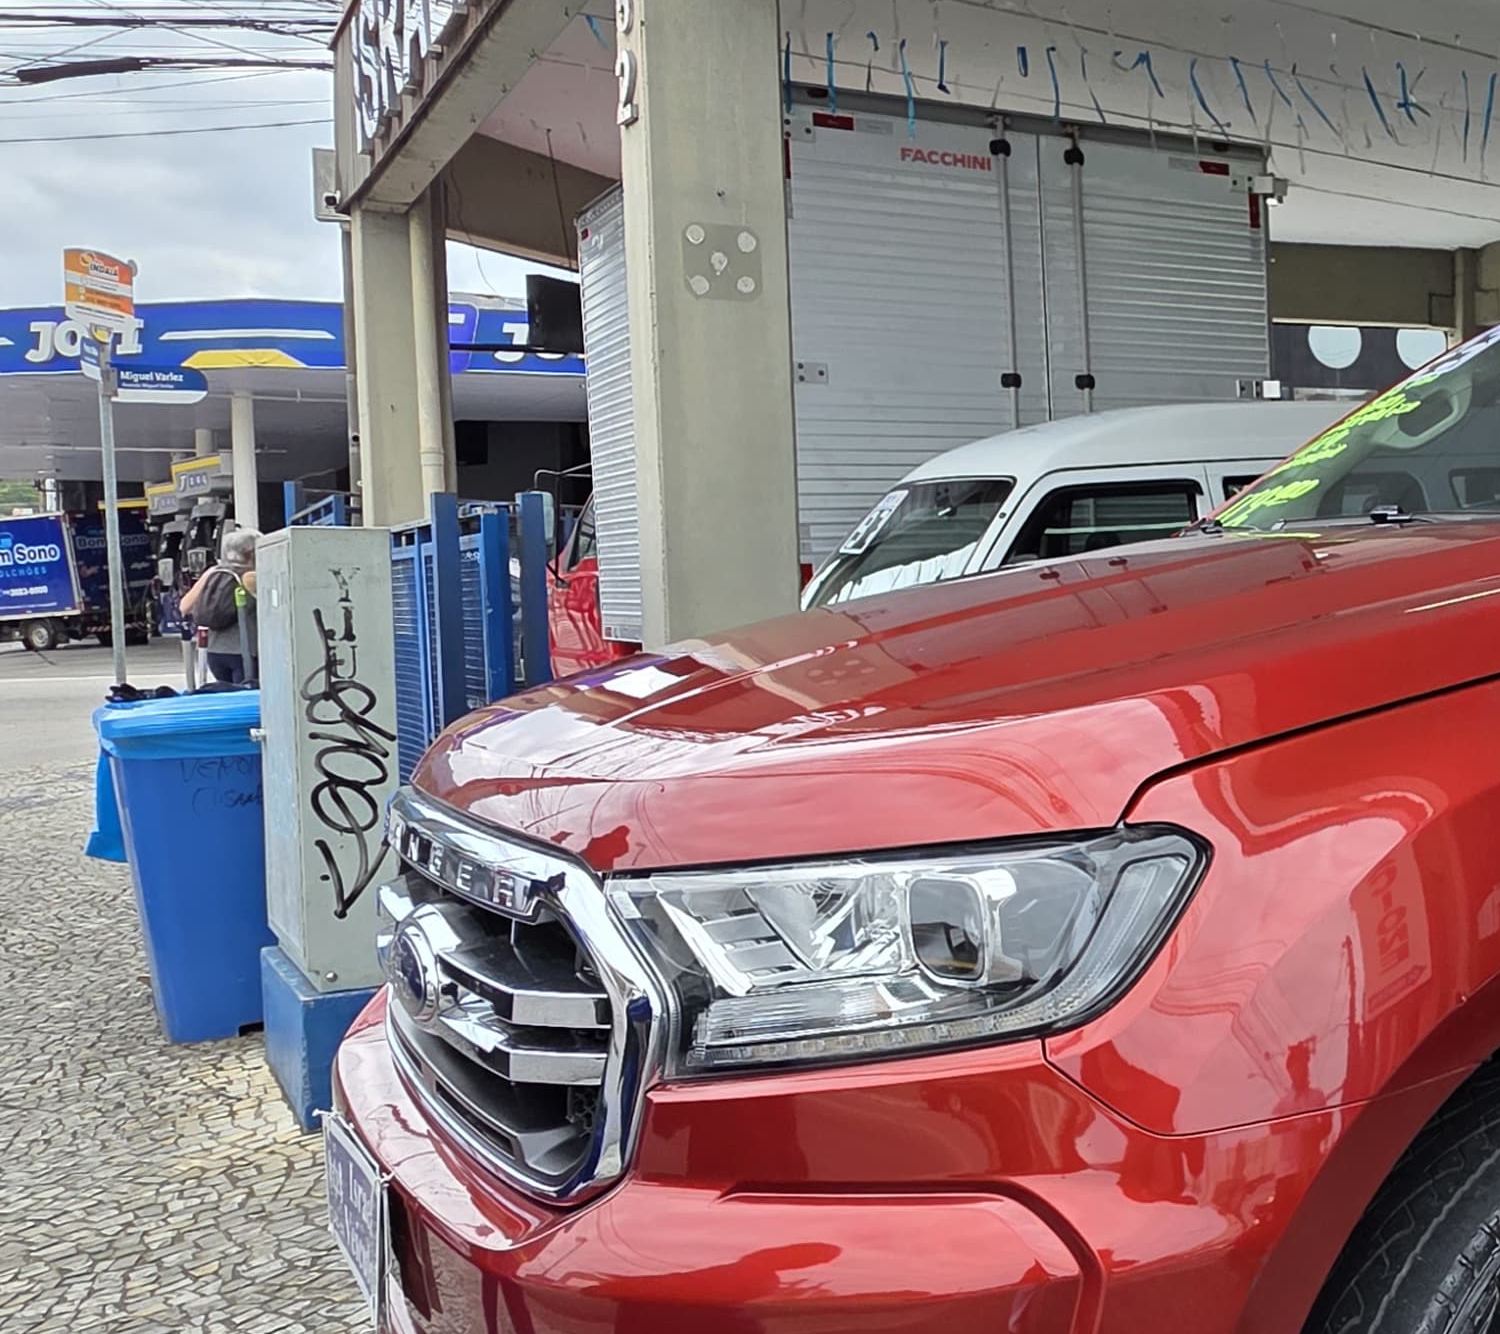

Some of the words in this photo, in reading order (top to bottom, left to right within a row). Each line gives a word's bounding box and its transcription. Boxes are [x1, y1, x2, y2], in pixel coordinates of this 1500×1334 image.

[901, 147, 992, 172] FACCHINI
[120, 370, 153, 382] Miguel
[14, 543, 60, 565] Sono
[393, 820, 515, 908] ANGER
